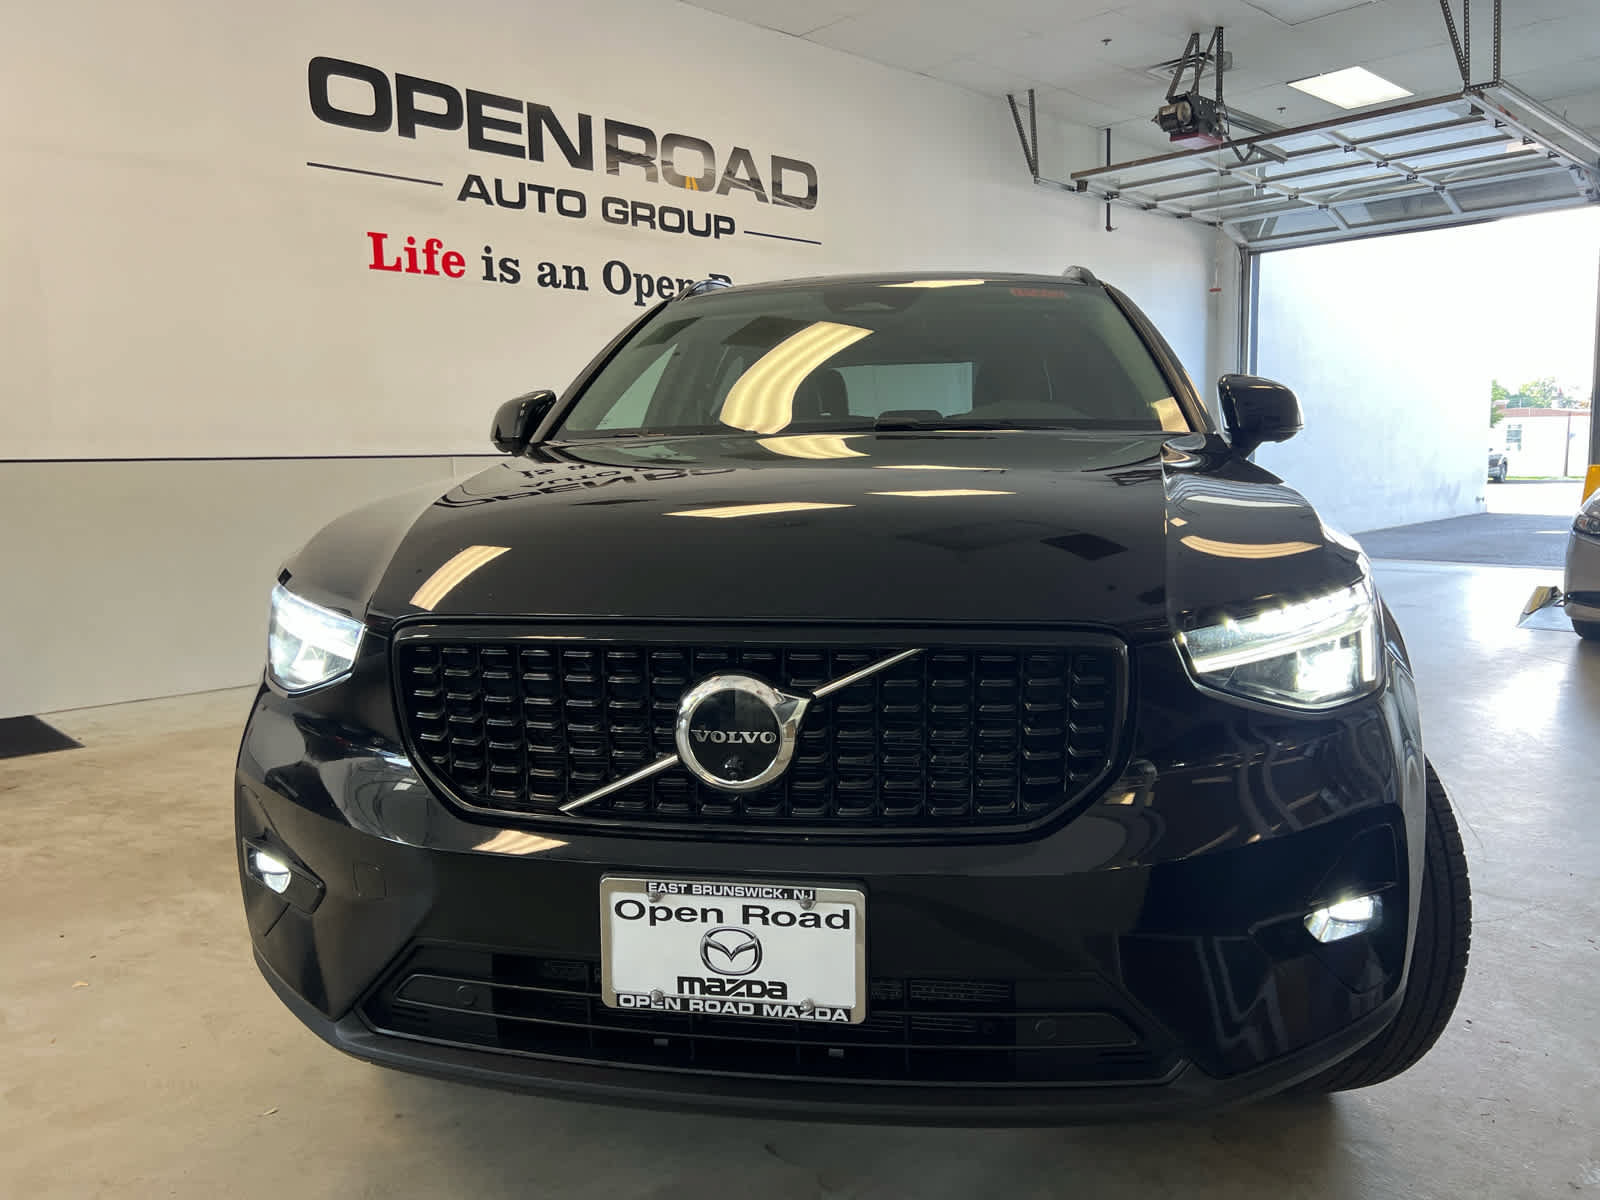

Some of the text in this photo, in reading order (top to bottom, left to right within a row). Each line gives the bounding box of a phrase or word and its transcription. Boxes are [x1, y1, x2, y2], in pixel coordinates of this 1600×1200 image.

[457, 175, 735, 239] AUTO GROUP
[367, 232, 466, 278] Life
[481, 246, 521, 284] is
[537, 257, 589, 291] an
[692, 730, 777, 744] VOLVO
[648, 883, 814, 900] EAST BRUNSWICK, NJ
[615, 900, 850, 929] Open Road
[619, 994, 848, 1021] OPEN ROAD MAZDA
